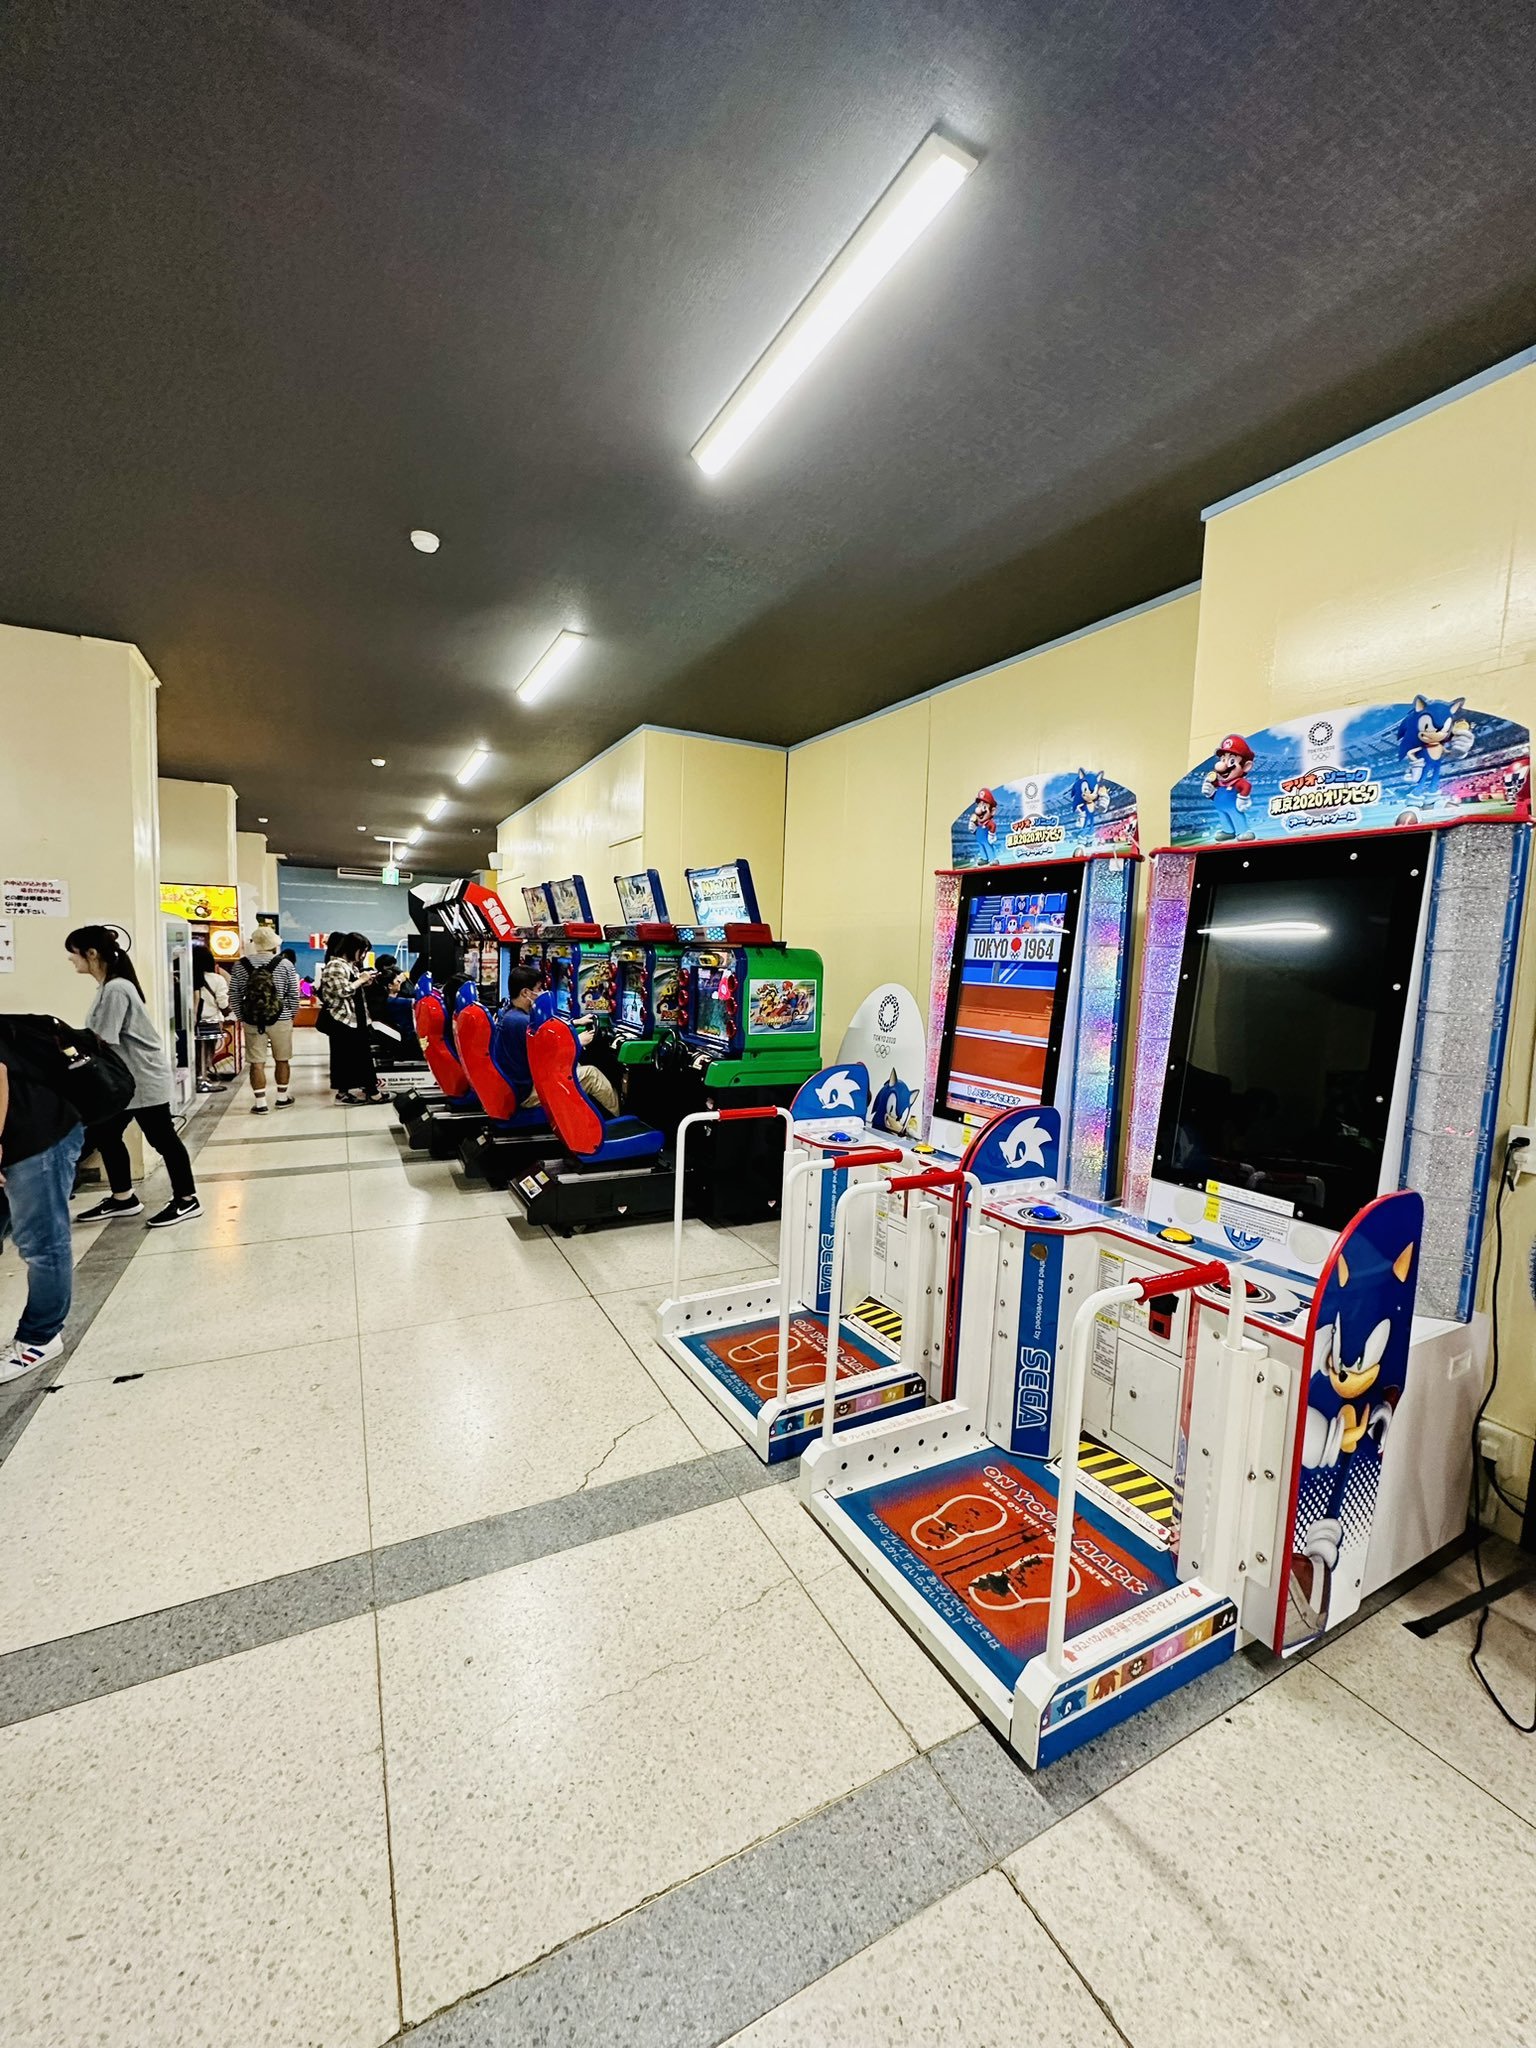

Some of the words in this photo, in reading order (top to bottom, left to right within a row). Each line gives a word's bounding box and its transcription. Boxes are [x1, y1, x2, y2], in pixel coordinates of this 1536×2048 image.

[1270, 784, 1379, 815] 東京2020オリンピック
[482, 897, 511, 937] SEGA
[973, 937, 1009, 959] TOKYO
[1023, 937, 1055, 960] 1964
[819, 1233, 835, 1295] SEGA
[1037, 1278, 1046, 1294] and
[1035, 1292, 1045, 1331] developed
[1033, 1329, 1042, 1341] by
[1016, 1346, 1051, 1430] SEGA
[982, 1481, 1009, 1501] STEP
[983, 1465, 1018, 1490] ON
[1013, 1488, 1075, 1536] YOU
[1072, 1539, 1149, 1596] MARK
[880, 1539, 903, 1562] なかに
[866, 1513, 930, 1573] ほかのプレイヤーが
[926, 1573, 1001, 1651] あそんでいるときは
